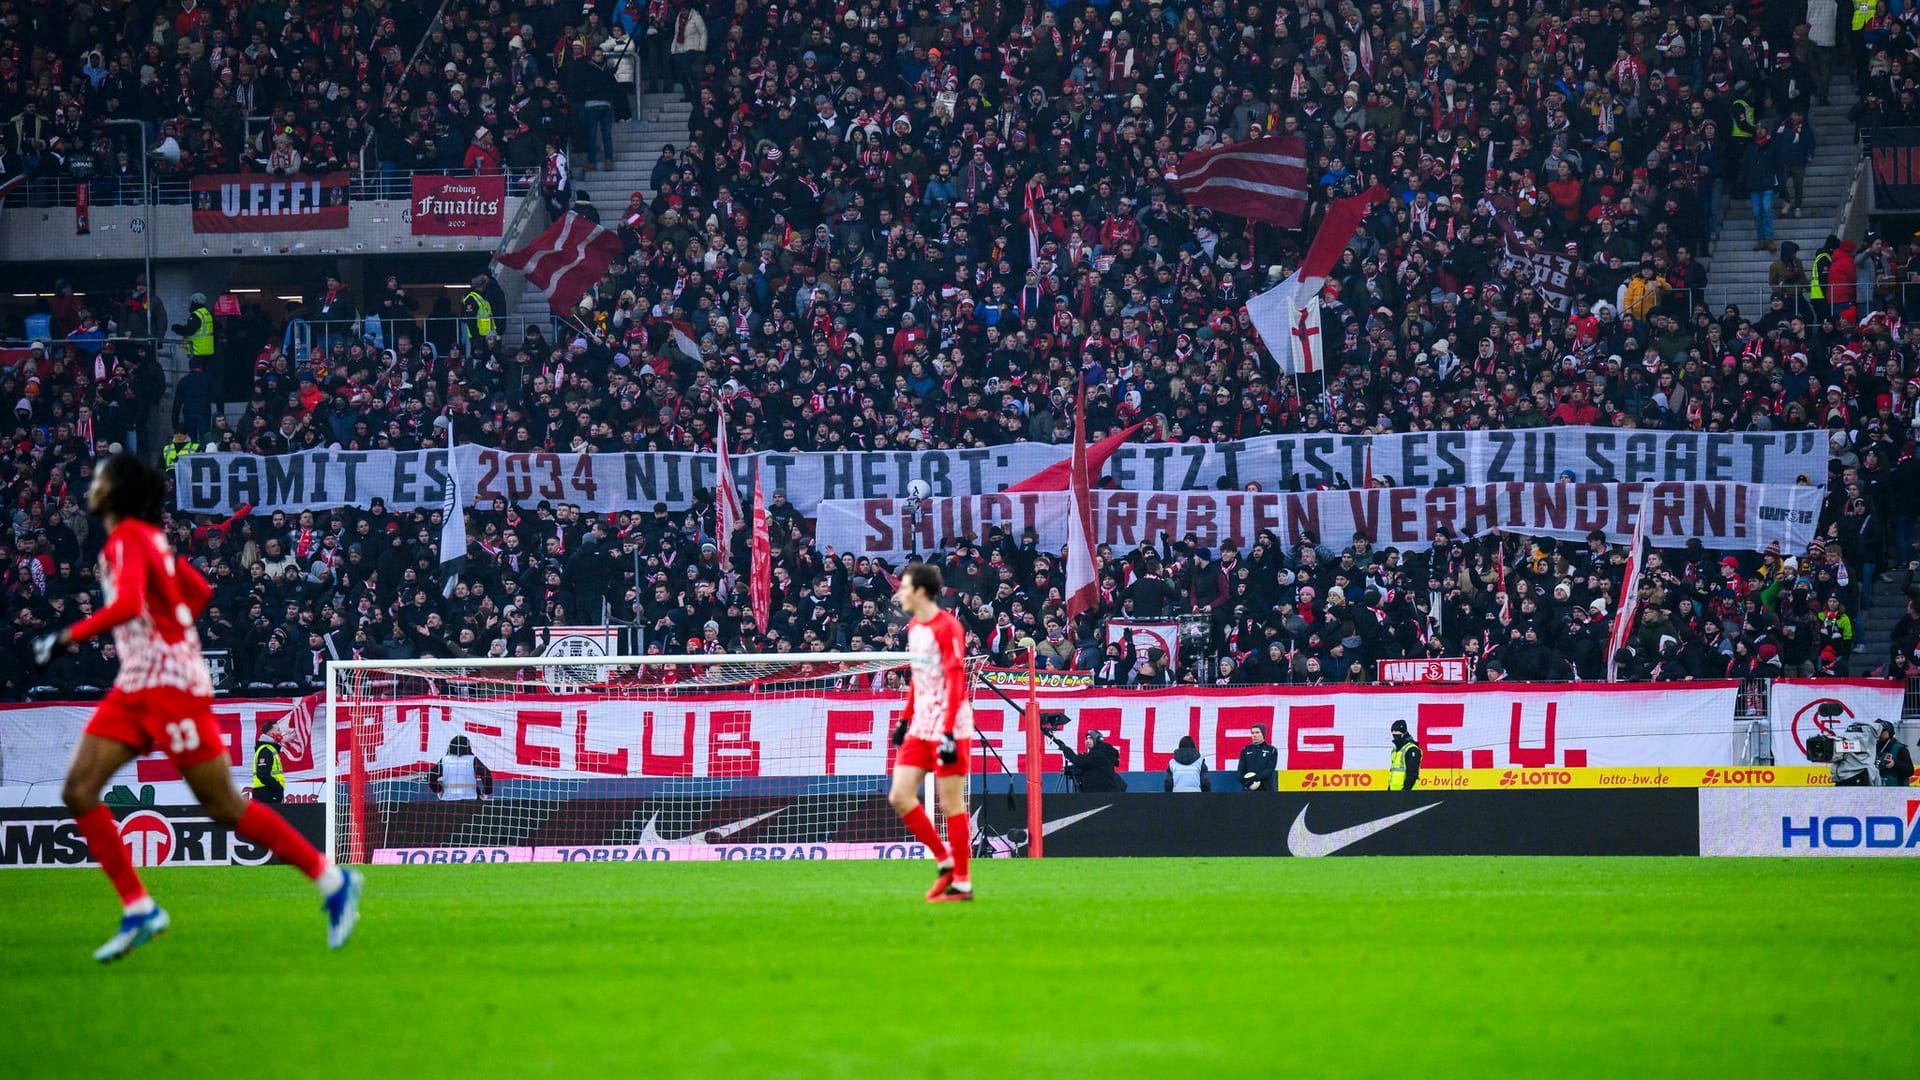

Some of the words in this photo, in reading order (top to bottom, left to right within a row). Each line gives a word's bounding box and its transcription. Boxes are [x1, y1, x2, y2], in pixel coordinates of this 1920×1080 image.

[442, 184, 476, 194] Freiburg
[221, 181, 321, 217] U.F.F.F.!
[416, 196, 499, 216] Fanatics
[191, 453, 367, 508] DAMIT
[393, 453, 449, 503] ES
[478, 450, 597, 501] 2034
[623, 453, 796, 501] NICHT
[1111, 441, 1246, 490] ETZT
[1277, 436, 1373, 490] IST
[1402, 433, 1466, 486] ES
[1487, 432, 1556, 482] ZU
[1349, 481, 1746, 544] VERHINDERN!
[1322, 773, 1372, 787] LOTTO
[1521, 771, 1571, 785] LOTTO
[1599, 772, 1669, 785] lotto-bw.de
[1723, 769, 1775, 784] LOTTO
[396, 849, 510, 864] JOBRAD
[557, 845, 670, 862] JOBRAD
[714, 846, 828, 861] JOBRAD
